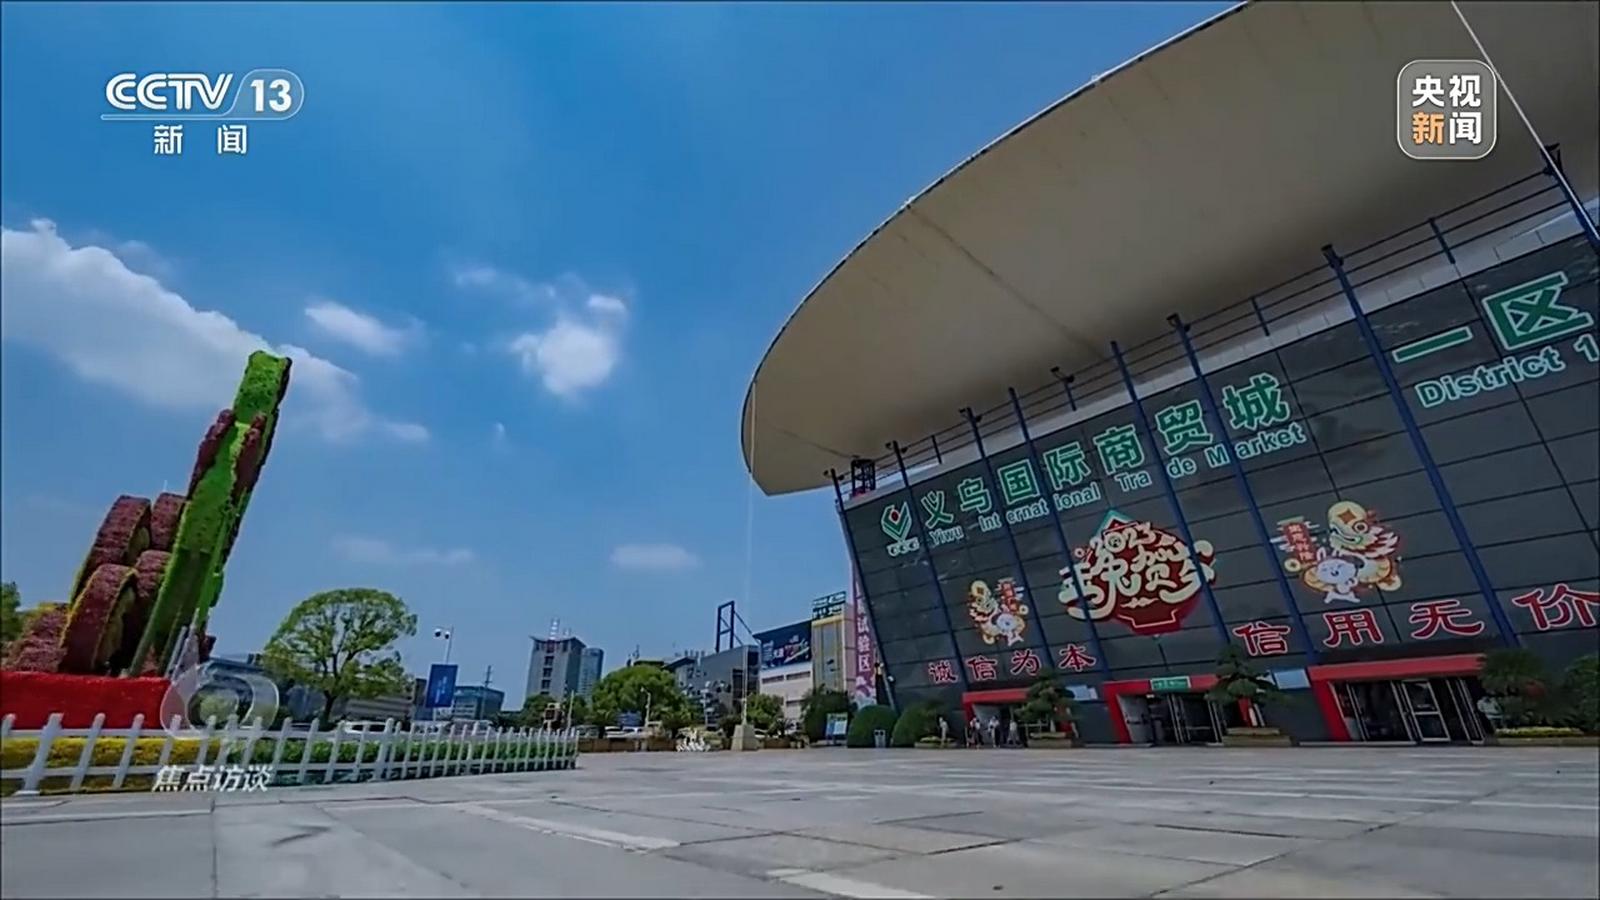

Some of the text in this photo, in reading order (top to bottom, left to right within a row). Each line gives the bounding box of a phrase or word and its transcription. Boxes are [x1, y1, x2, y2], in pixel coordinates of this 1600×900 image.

[1392, 271, 1594, 363] 一区
[1415, 346, 1566, 408] District
[920, 373, 1290, 529] 义乌国际商贸城
[929, 525, 965, 549] Yiwu
[1232, 583, 1600, 657] 信用无价
[928, 643, 1097, 684] 诚信为本
